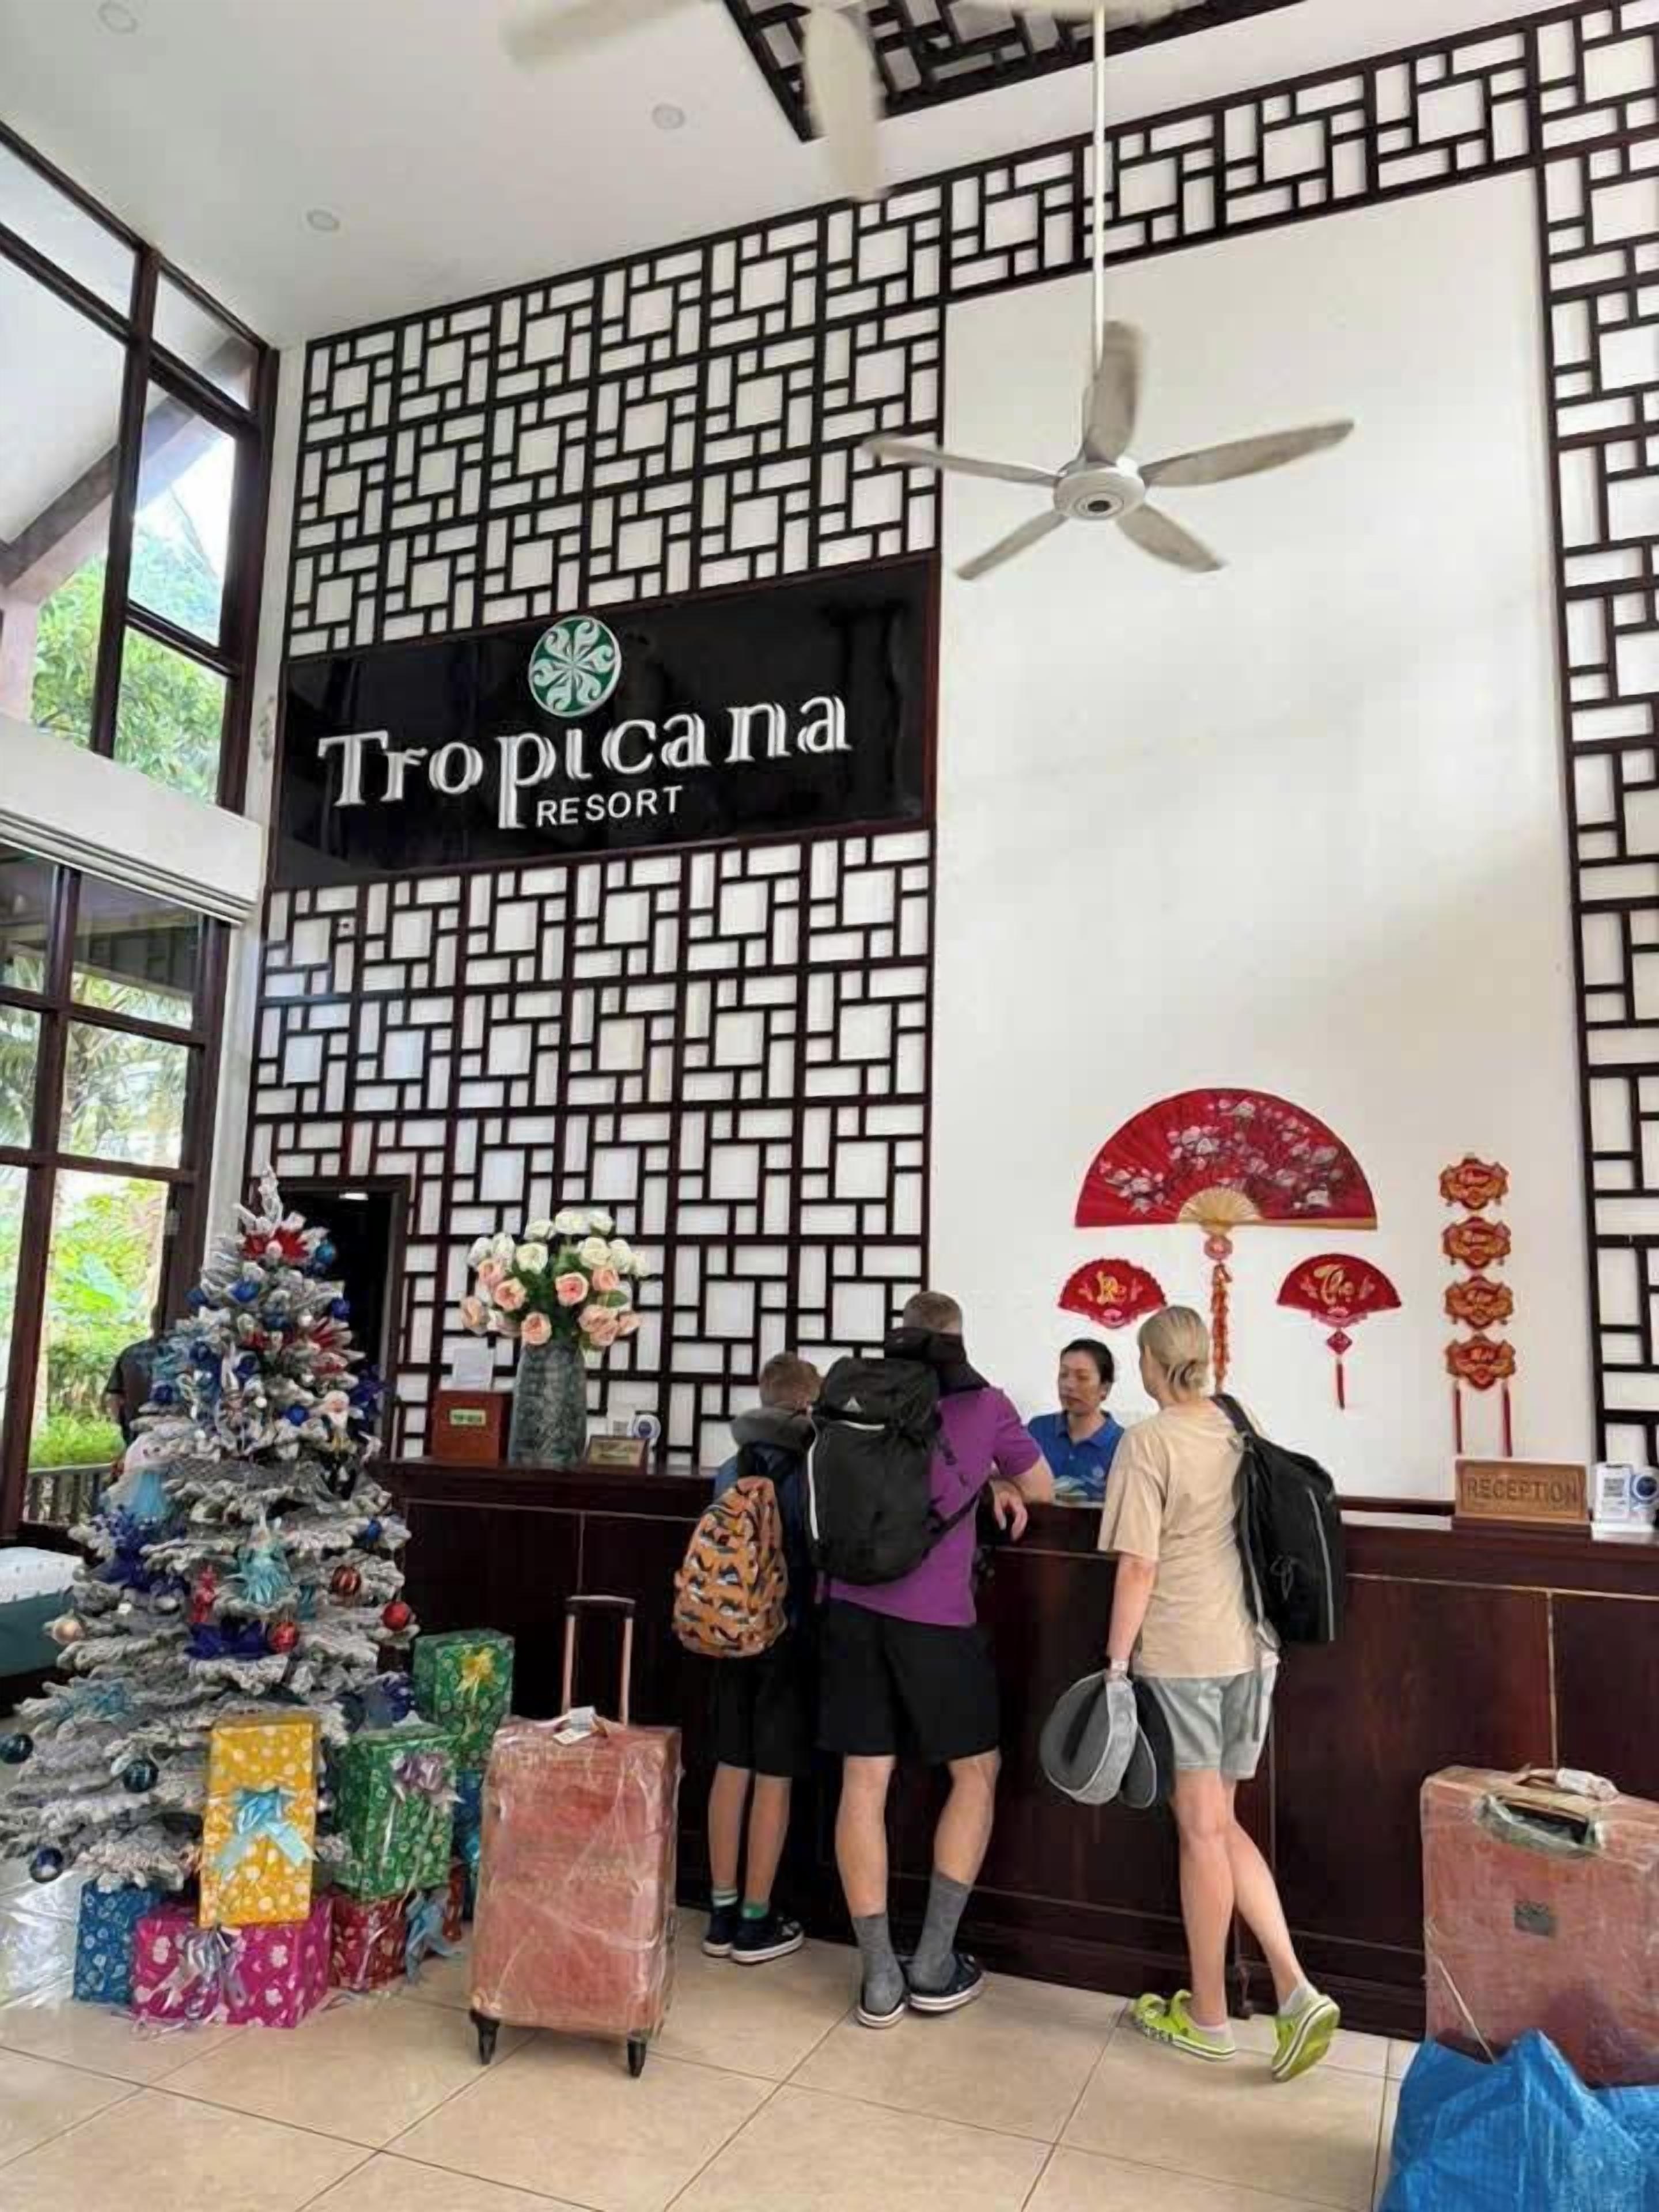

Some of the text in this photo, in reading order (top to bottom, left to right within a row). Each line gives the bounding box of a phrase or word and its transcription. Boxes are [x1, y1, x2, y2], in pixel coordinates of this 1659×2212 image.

[317, 694, 853, 830] Tropicana
[536, 785, 683, 827] RESORT
[1467, 1476, 1577, 1503] RECEPTION
